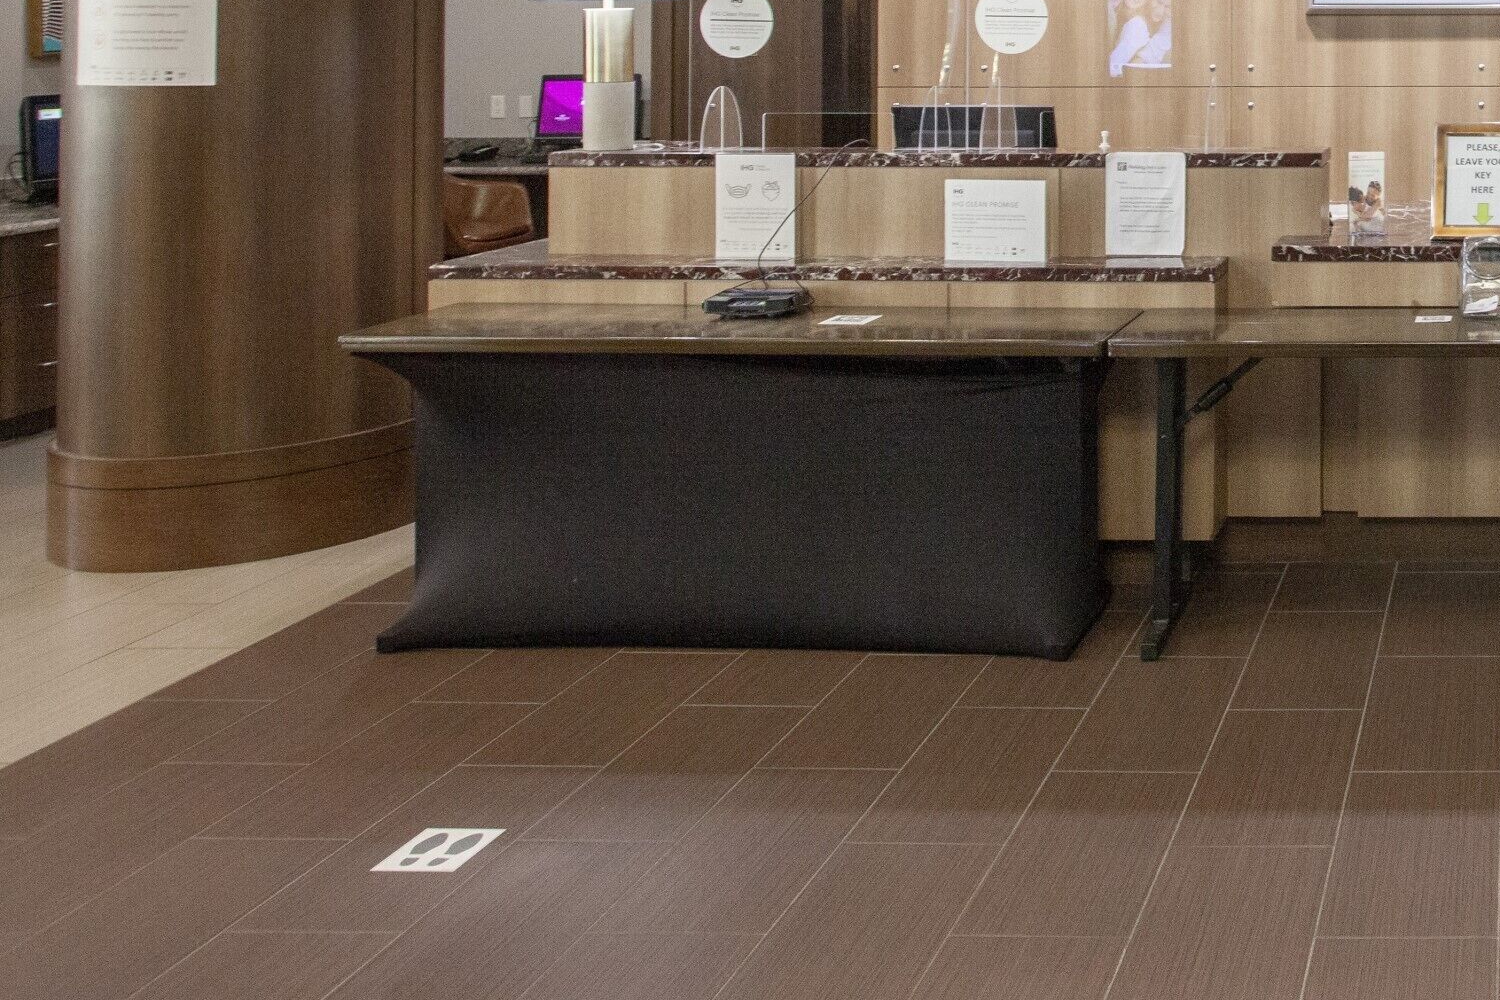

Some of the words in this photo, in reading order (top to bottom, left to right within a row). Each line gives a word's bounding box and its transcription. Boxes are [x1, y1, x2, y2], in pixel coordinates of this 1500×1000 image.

[1466, 143, 1500, 152] PLEASE,
[1455, 158, 1482, 166] LEAVE
[1474, 171, 1492, 180] KEY
[1470, 186, 1494, 194] HERE
